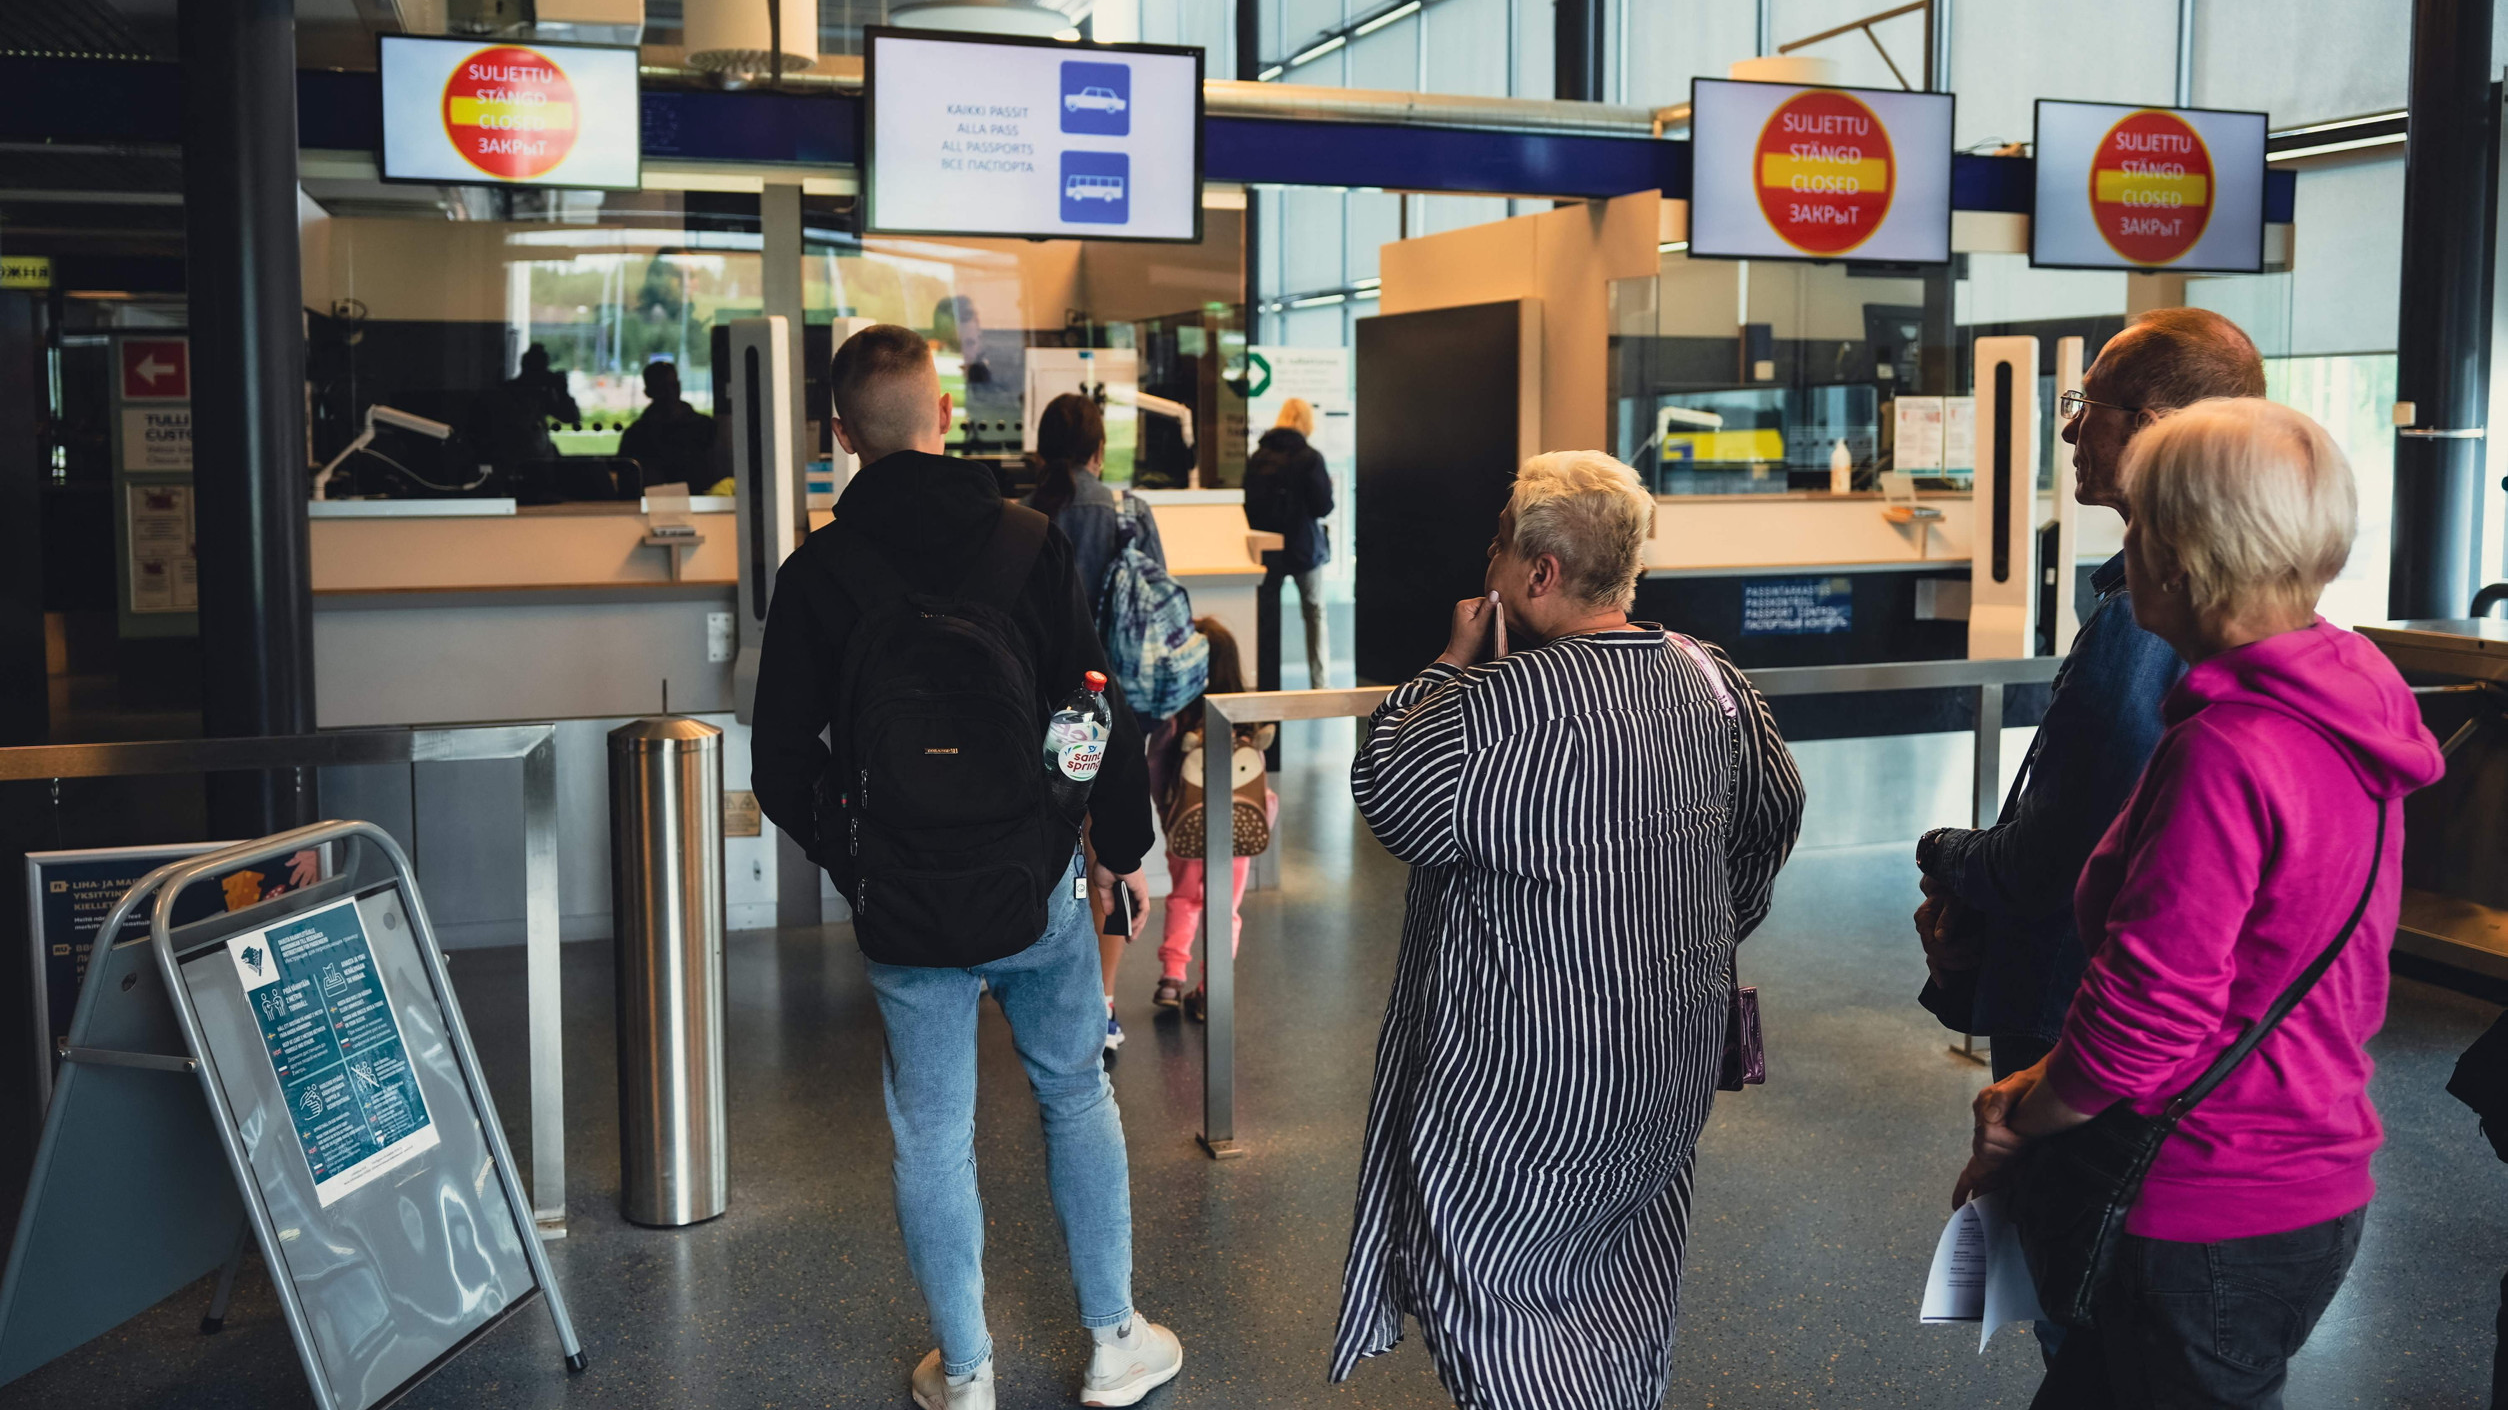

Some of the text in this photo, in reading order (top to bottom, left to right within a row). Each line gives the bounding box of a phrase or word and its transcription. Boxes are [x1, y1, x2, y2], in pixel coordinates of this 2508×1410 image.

[469, 63, 553, 84] SULJETTU
[476, 87, 547, 107] STÄNGD
[947, 104, 1028, 118] KAIKKI PASSIT
[478, 114, 545, 131] CLOSED
[957, 122, 1019, 136] ALLA PASS
[1783, 112, 1869, 136] SULJETTU
[942, 140, 1034, 155] ALL PASSPORTS
[1789, 140, 1862, 165] STÄNGD
[2115, 131, 2192, 154] SULJETTU
[2121, 157, 2185, 180] STÄNGD
[1791, 174, 1860, 195] CLOSED
[2122, 189, 2182, 209] CLOSED
[1744, 606, 1794, 618] PASSPORT
[1073, 752, 1102, 762] saint
[72, 881, 100, 890] LIHA-
[102, 880, 114, 889] JA
